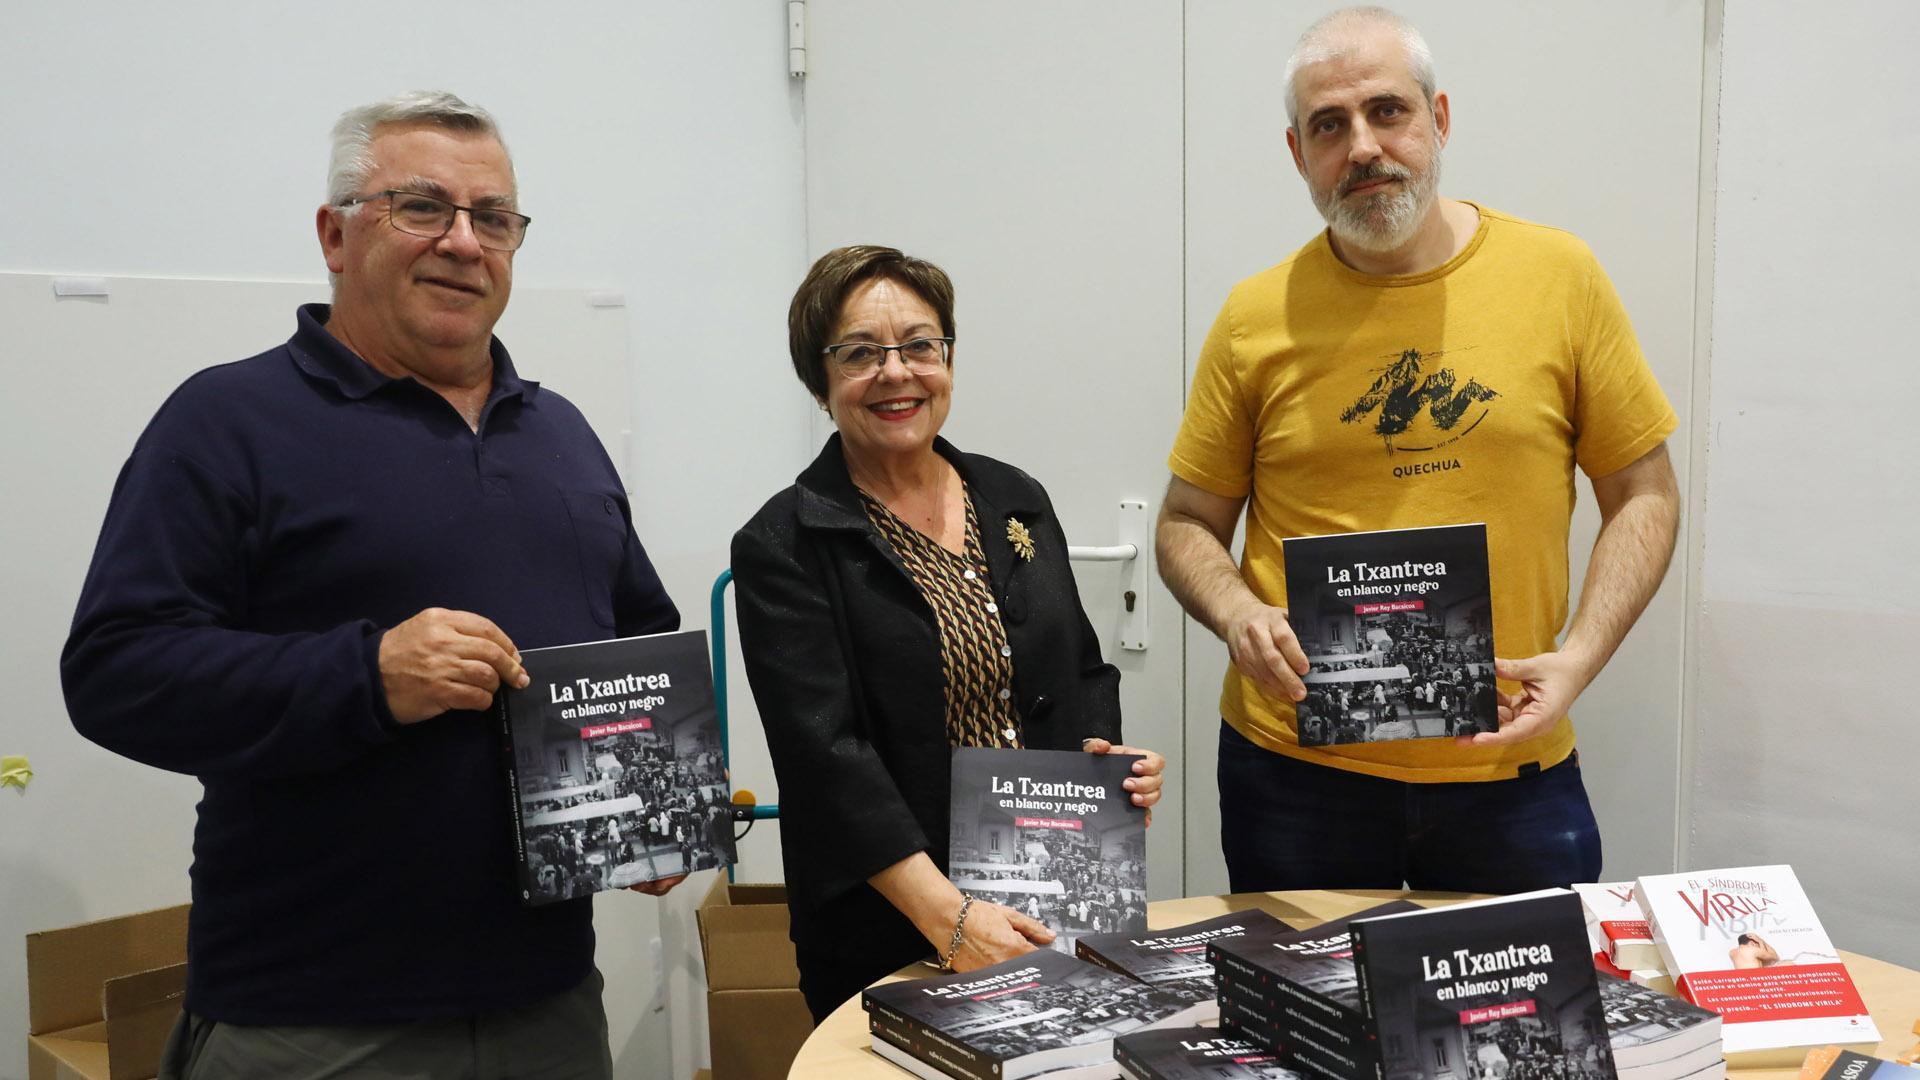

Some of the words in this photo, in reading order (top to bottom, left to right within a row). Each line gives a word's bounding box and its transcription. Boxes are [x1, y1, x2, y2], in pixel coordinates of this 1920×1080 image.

[1393, 459, 1461, 478] QUECHUA
[1327, 566, 1351, 584] La
[1354, 560, 1447, 582] Txantrea
[1337, 587, 1352, 597] en
[1353, 583, 1392, 596] blanco
[1394, 584, 1402, 595] y
[1404, 580, 1440, 594] negro
[550, 683, 575, 704] La
[576, 673, 672, 700] Txantrea
[561, 708, 577, 719] en
[577, 703, 618, 717] blanco
[619, 701, 627, 715] y
[629, 695, 665, 711] negro
[991, 776, 1014, 794] La
[1018, 777, 1106, 800] Txantrea
[999, 799, 1014, 808] en
[1015, 797, 1053, 810] blanco
[1055, 802, 1062, 813] y
[1064, 801, 1098, 815] negro
[1688, 879, 1702, 890] EL
[1677, 888, 1777, 926] VIRILA
[1155, 925, 1245, 944] Txantrea
[1163, 940, 1202, 949] blanco
[1272, 943, 1307, 951] La
[1421, 955, 1452, 981] La
[1453, 943, 1553, 976] Txantrea
[922, 988, 953, 996] La
[947, 967, 1040, 991] Txantrea
[958, 985, 999, 996] blanco
[1008, 973, 1042, 985] negro
[1436, 985, 1455, 1001] en
[1456, 979, 1500, 998] blanco
[1501, 977, 1510, 995] y
[1512, 970, 1548, 992] negro
[1180, 1041, 1214, 1050] La
